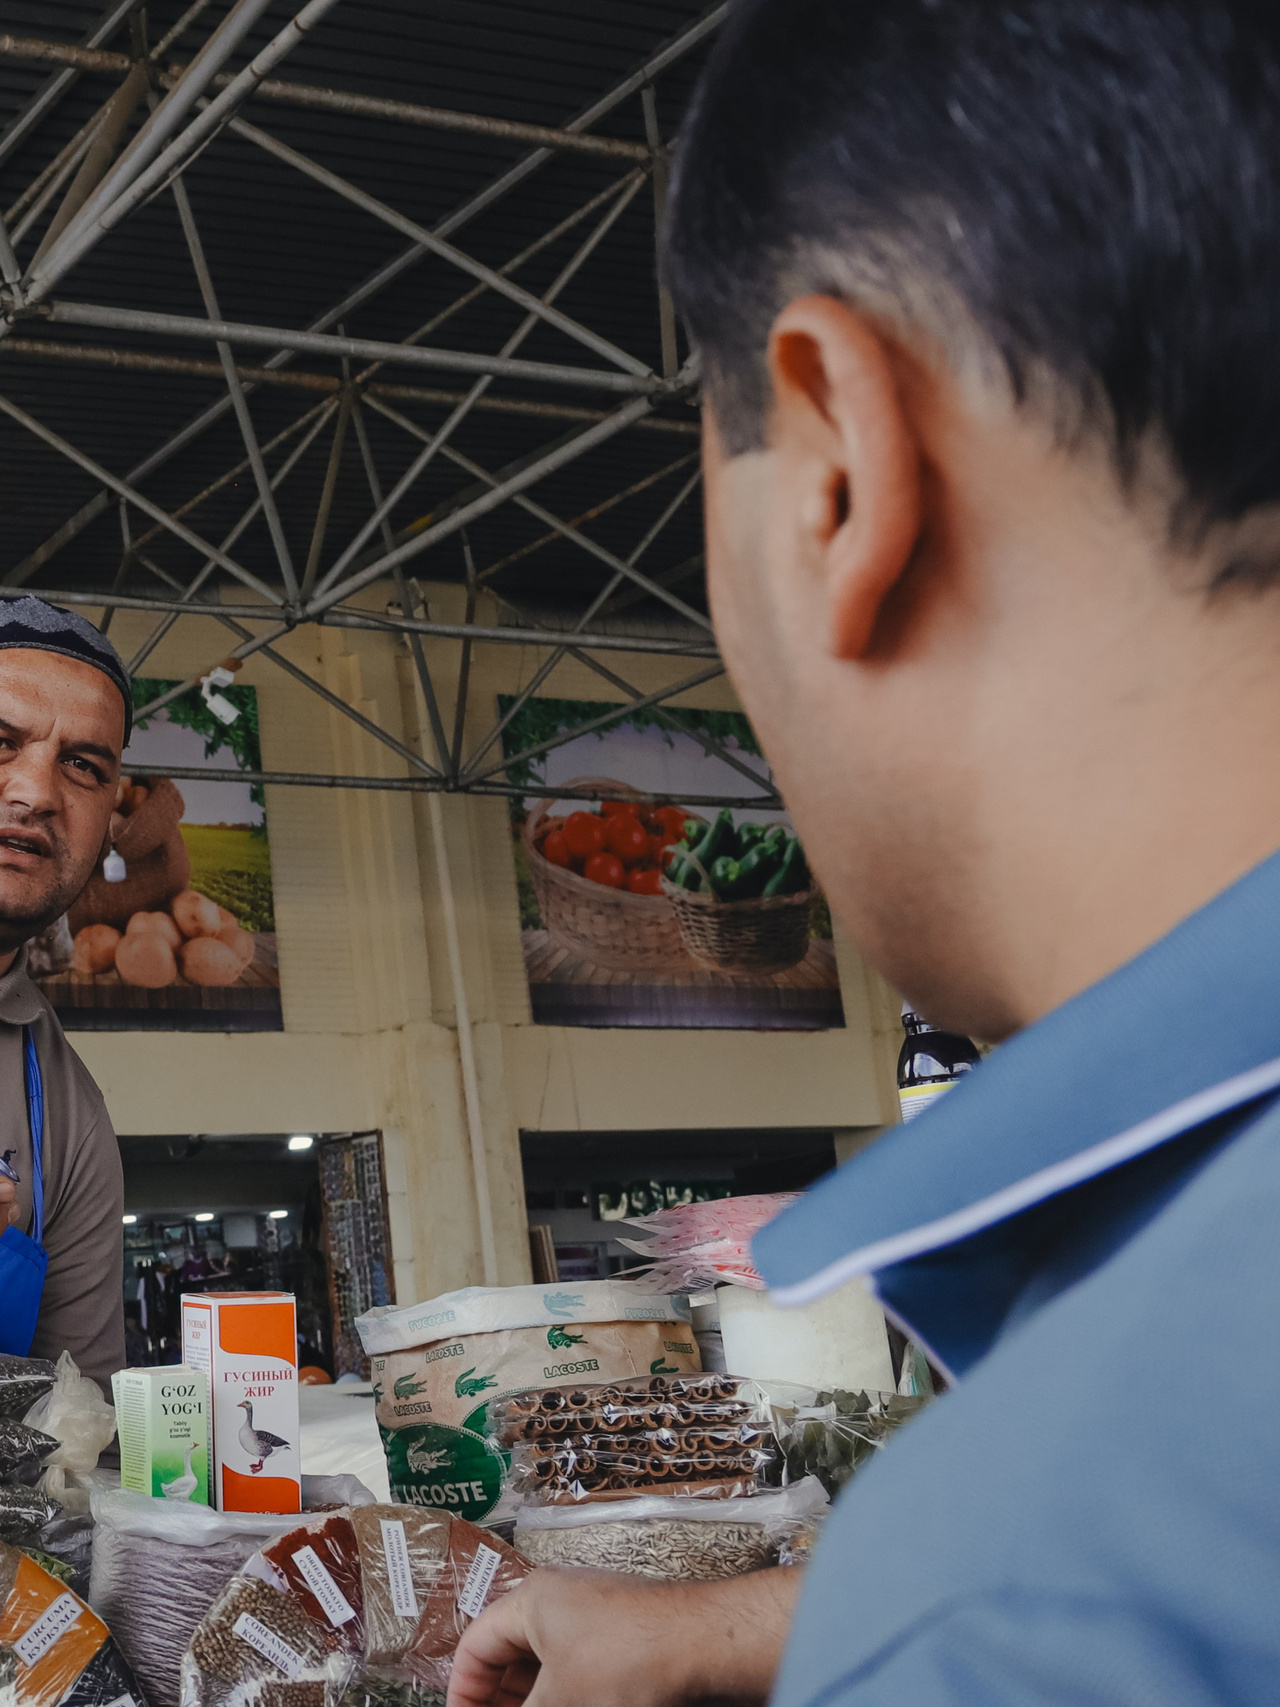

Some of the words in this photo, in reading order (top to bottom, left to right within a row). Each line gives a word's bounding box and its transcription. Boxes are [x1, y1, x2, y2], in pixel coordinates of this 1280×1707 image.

[425, 1343, 466, 1364] LACOSTE
[543, 1358, 599, 1379] LACOSTE
[223, 1367, 293, 1383] ГУСИНЫЙ
[244, 1385, 275, 1397] ЖИР
[394, 1401, 433, 1417] LACOSTE
[402, 1480, 488, 1507] LACOSTE
[393, 1529, 404, 1562] POWDER
[298, 1559, 320, 1587] СУХОЙ
[314, 1583, 337, 1614] ТОМАТ
[305, 1554, 324, 1580] DRIED
[320, 1576, 345, 1612] TOMATO
[398, 1563, 410, 1608] CORIANDER
[21, 1598, 70, 1651] CURCUMA
[27, 1609, 77, 1661] КУРКУМА
